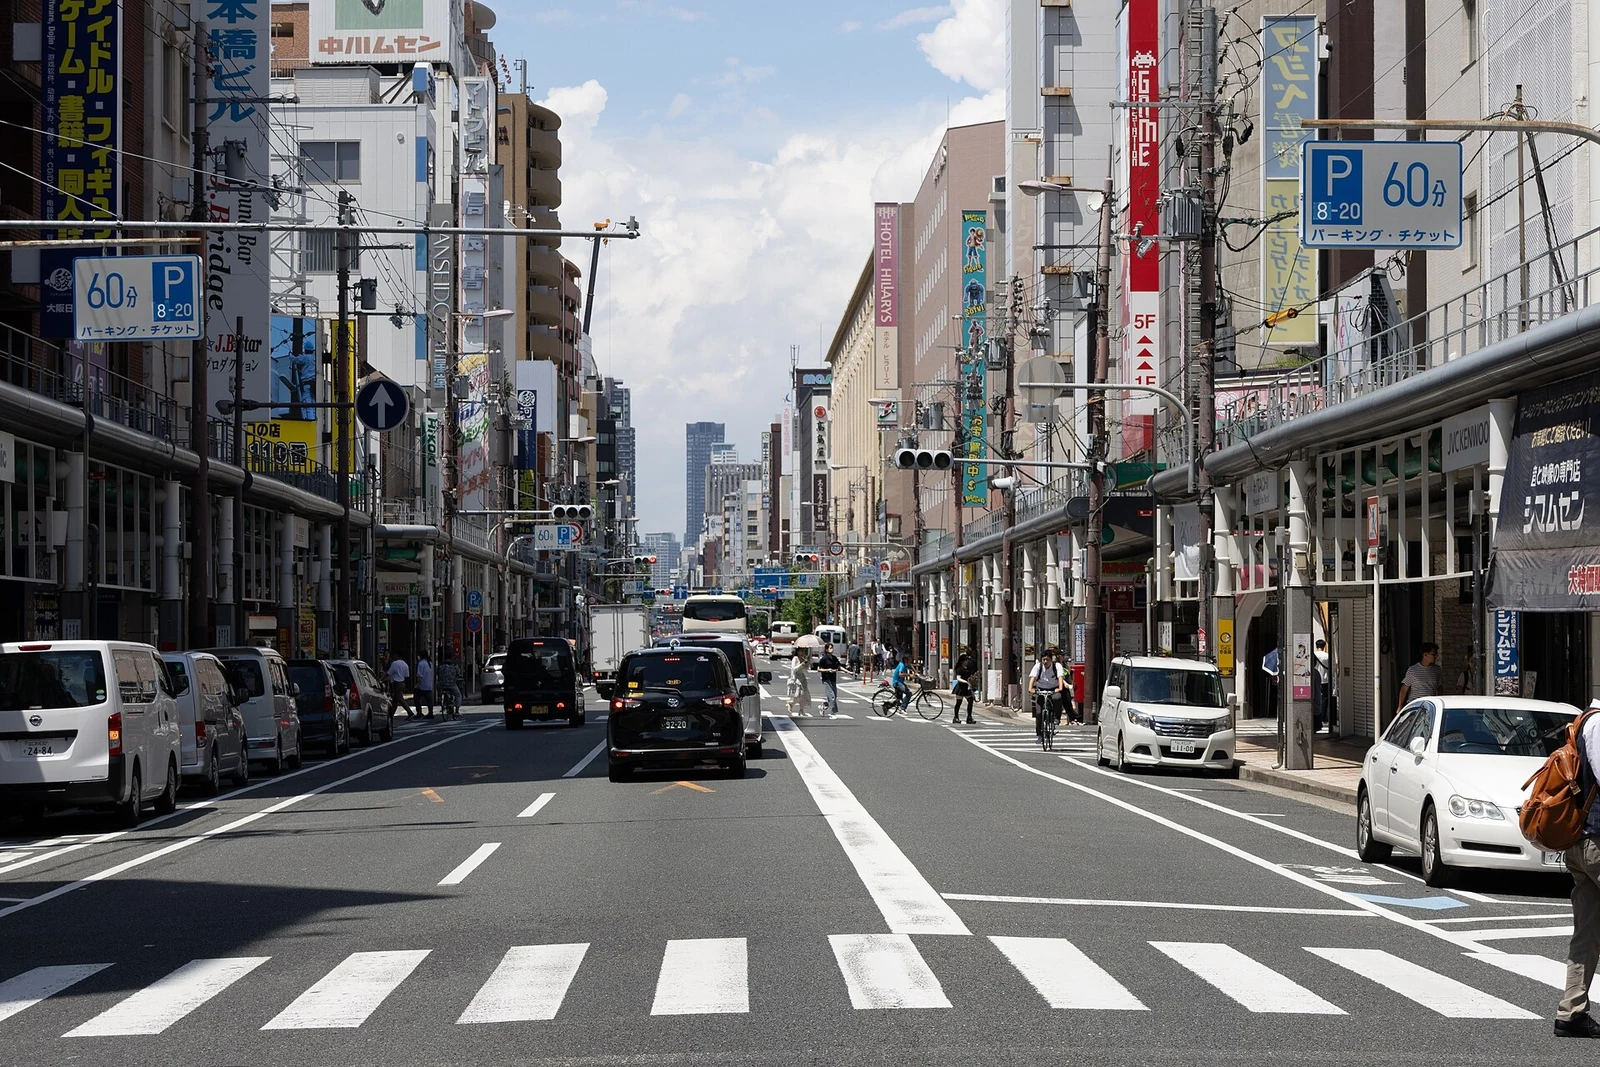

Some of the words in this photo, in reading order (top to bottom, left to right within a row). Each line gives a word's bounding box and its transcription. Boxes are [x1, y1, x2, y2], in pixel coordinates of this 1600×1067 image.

[318, 35, 441, 56] 中川ムセン
[1138, 70, 1157, 167] GAME
[1327, 155, 1353, 197] P
[1317, 202, 1361, 220] 8-20
[880, 221, 892, 263] HOTEL
[1311, 229, 1455, 242] パーキング・チケット
[237, 233, 257, 265] Bar
[164, 266, 185, 299] P
[880, 268, 895, 323] HILLARYS
[157, 303, 192, 319] 8-20
[81, 324, 196, 338] パーキング・チケット
[1133, 314, 1156, 330] 5F
[560, 527, 569, 538] P
[28, 746, 52, 756] 24-84
